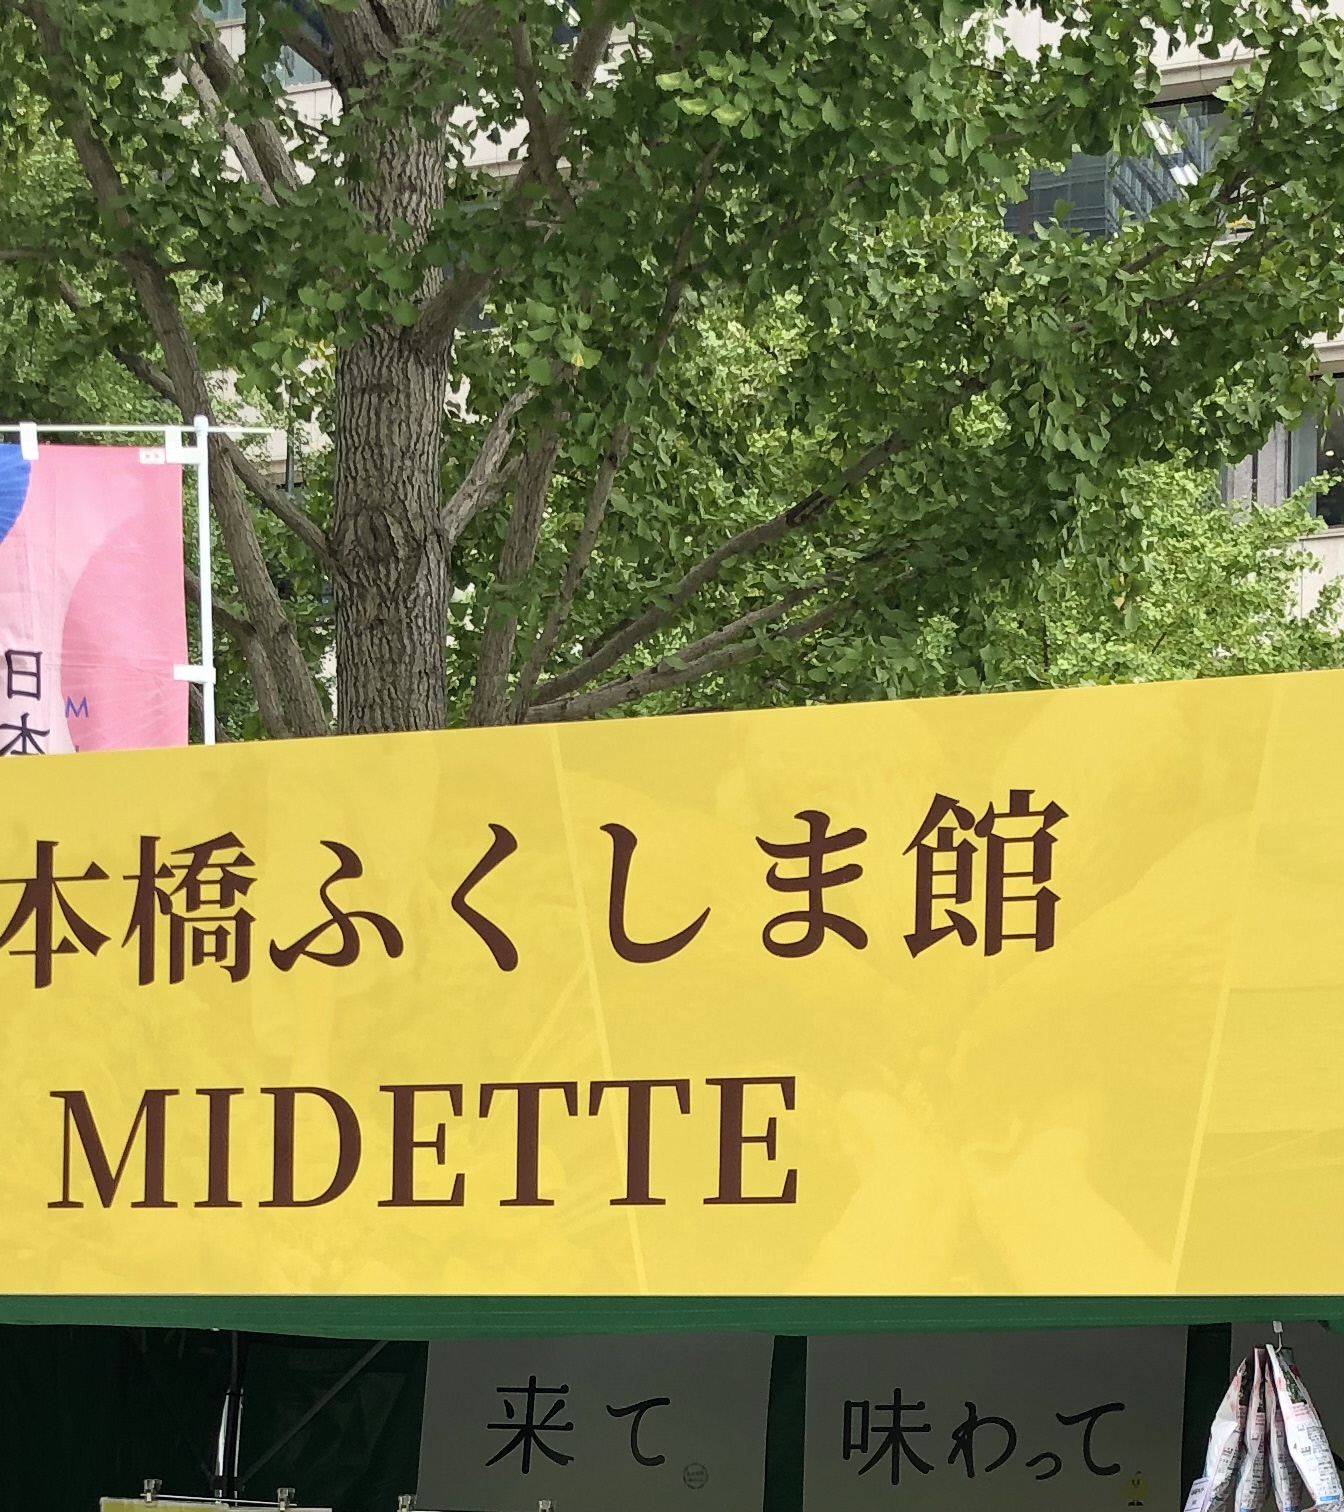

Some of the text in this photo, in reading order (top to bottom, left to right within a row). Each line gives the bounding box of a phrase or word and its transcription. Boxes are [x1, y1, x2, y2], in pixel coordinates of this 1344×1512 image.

[48, 1076, 798, 1210] MIDETTE
[486, 1375, 670, 1474] 来て
[843, 1388, 1126, 1485] 味わって
